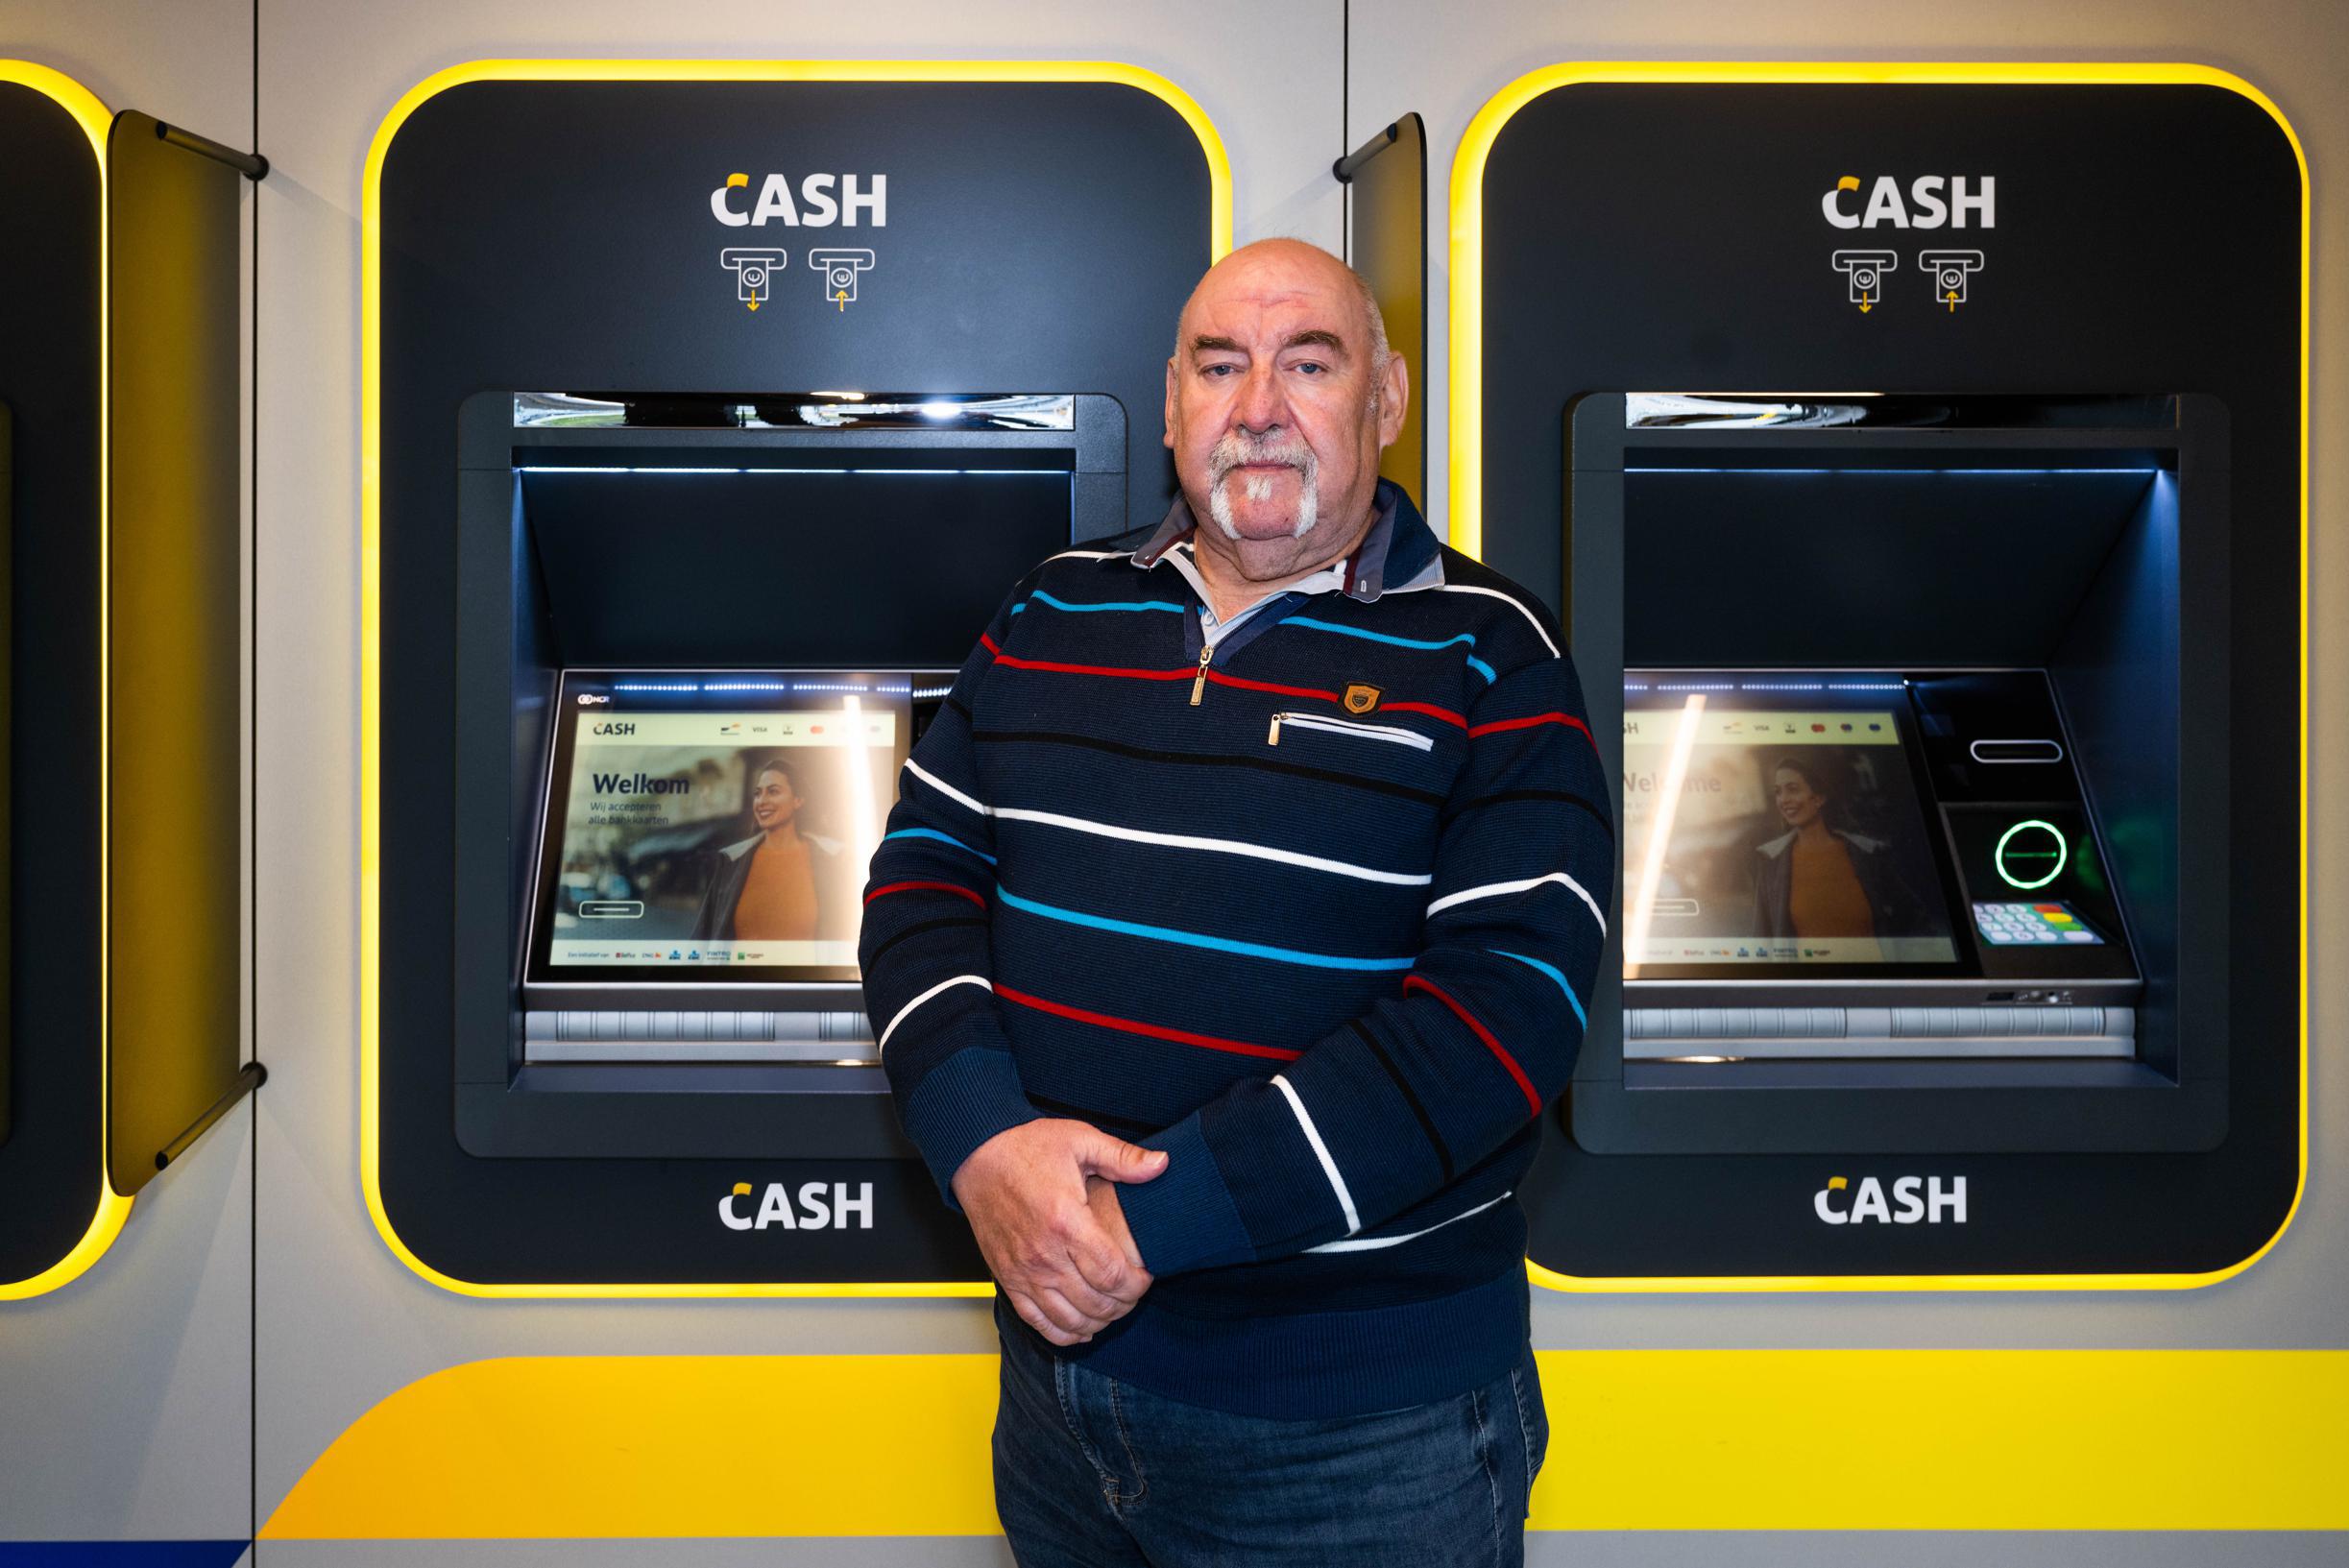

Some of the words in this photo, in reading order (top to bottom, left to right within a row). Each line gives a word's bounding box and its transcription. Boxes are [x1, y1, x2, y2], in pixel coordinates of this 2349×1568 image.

[711, 173, 886, 227] CASH
[1822, 175, 1996, 229] CASH
[593, 722, 636, 736] CASH
[593, 773, 690, 794] Welkom
[1624, 772, 1722, 793] elme
[591, 802, 606, 812] Wij
[608, 803, 661, 812] accepteren
[588, 815, 606, 825] alle
[609, 814, 669, 826] bankkaarten
[718, 1182, 873, 1230] CASH
[1814, 1175, 1967, 1224] CASH
